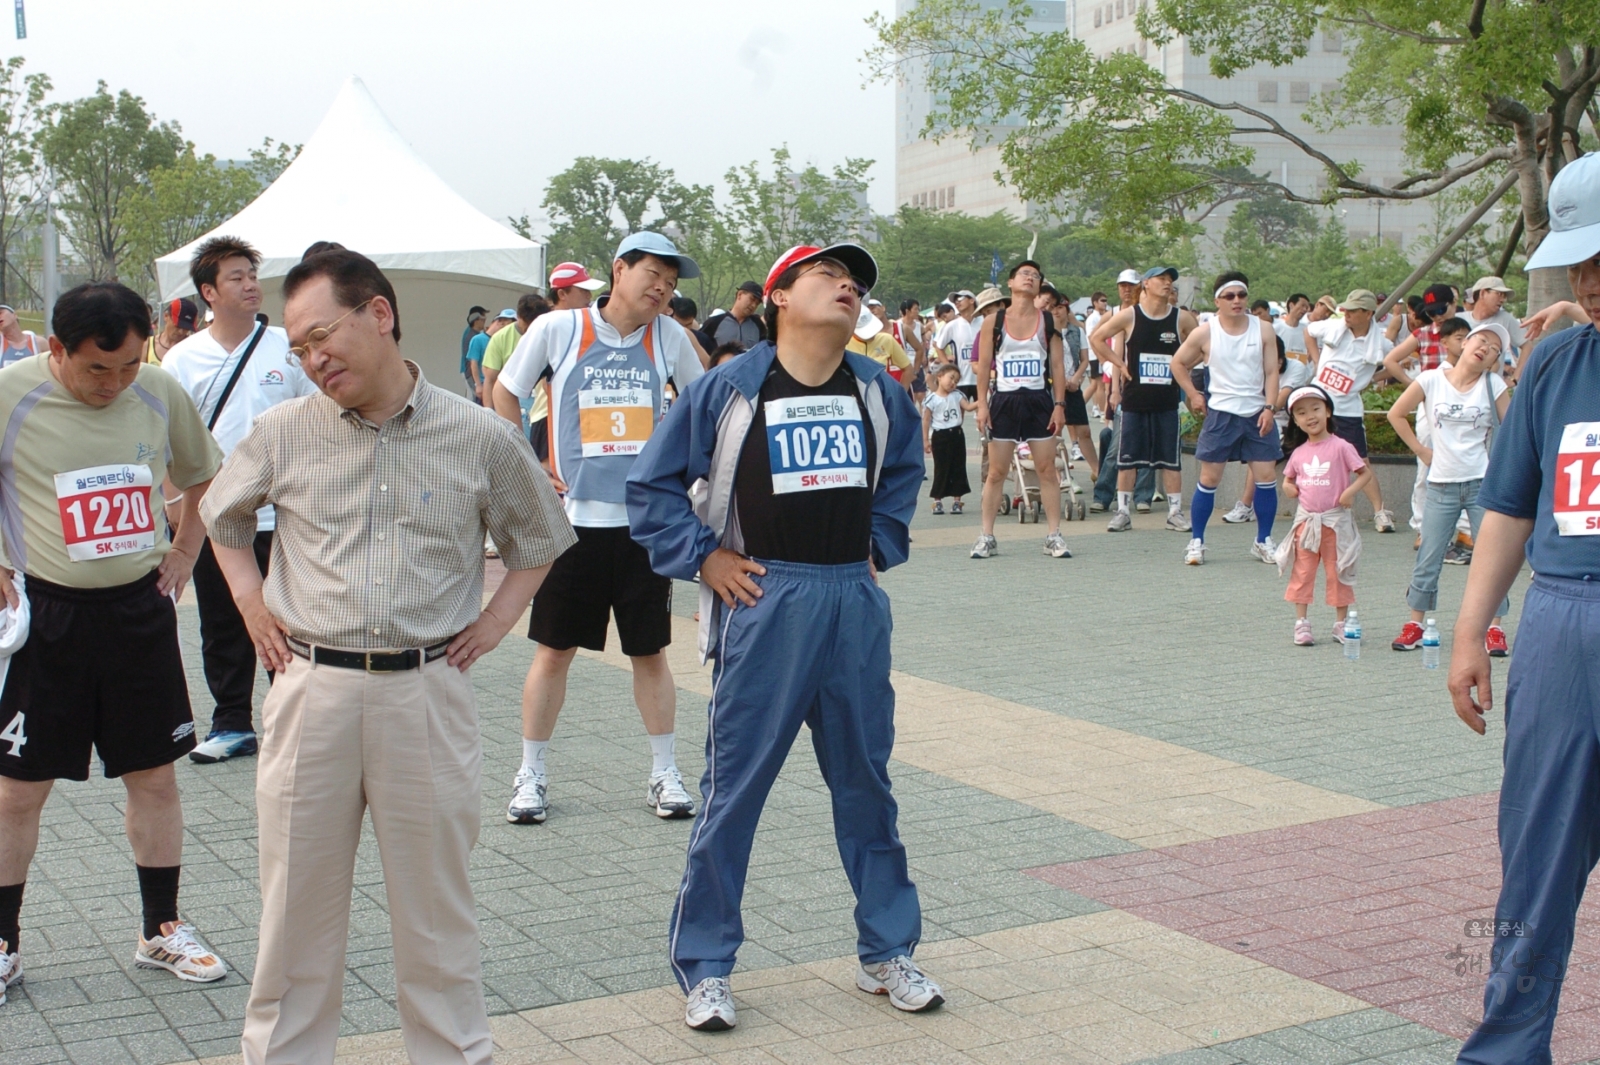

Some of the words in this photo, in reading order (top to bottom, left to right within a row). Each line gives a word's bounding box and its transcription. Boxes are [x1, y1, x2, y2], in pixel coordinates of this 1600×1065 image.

[583, 366, 651, 383] Powerfull
[1005, 361, 1039, 377] 10710
[1141, 362, 1171, 378] 10807
[1322, 369, 1352, 395] 1551
[594, 391, 639, 405] 월드메르디앙
[785, 398, 845, 419] 월드메르디앙
[610, 411, 627, 437] 3
[774, 424, 863, 468] 10238
[1585, 433, 1600, 447] 월
[602, 445, 615, 453] SK
[76, 466, 136, 490] 월드메르디앙
[801, 474, 820, 487] SK
[820, 473, 849, 485] 주식회사
[1301, 477, 1331, 486] adidas
[66, 490, 150, 539] 1220
[96, 541, 114, 555] SK
[114, 540, 138, 552] 주식회사
[0, 710, 28, 758] 4
